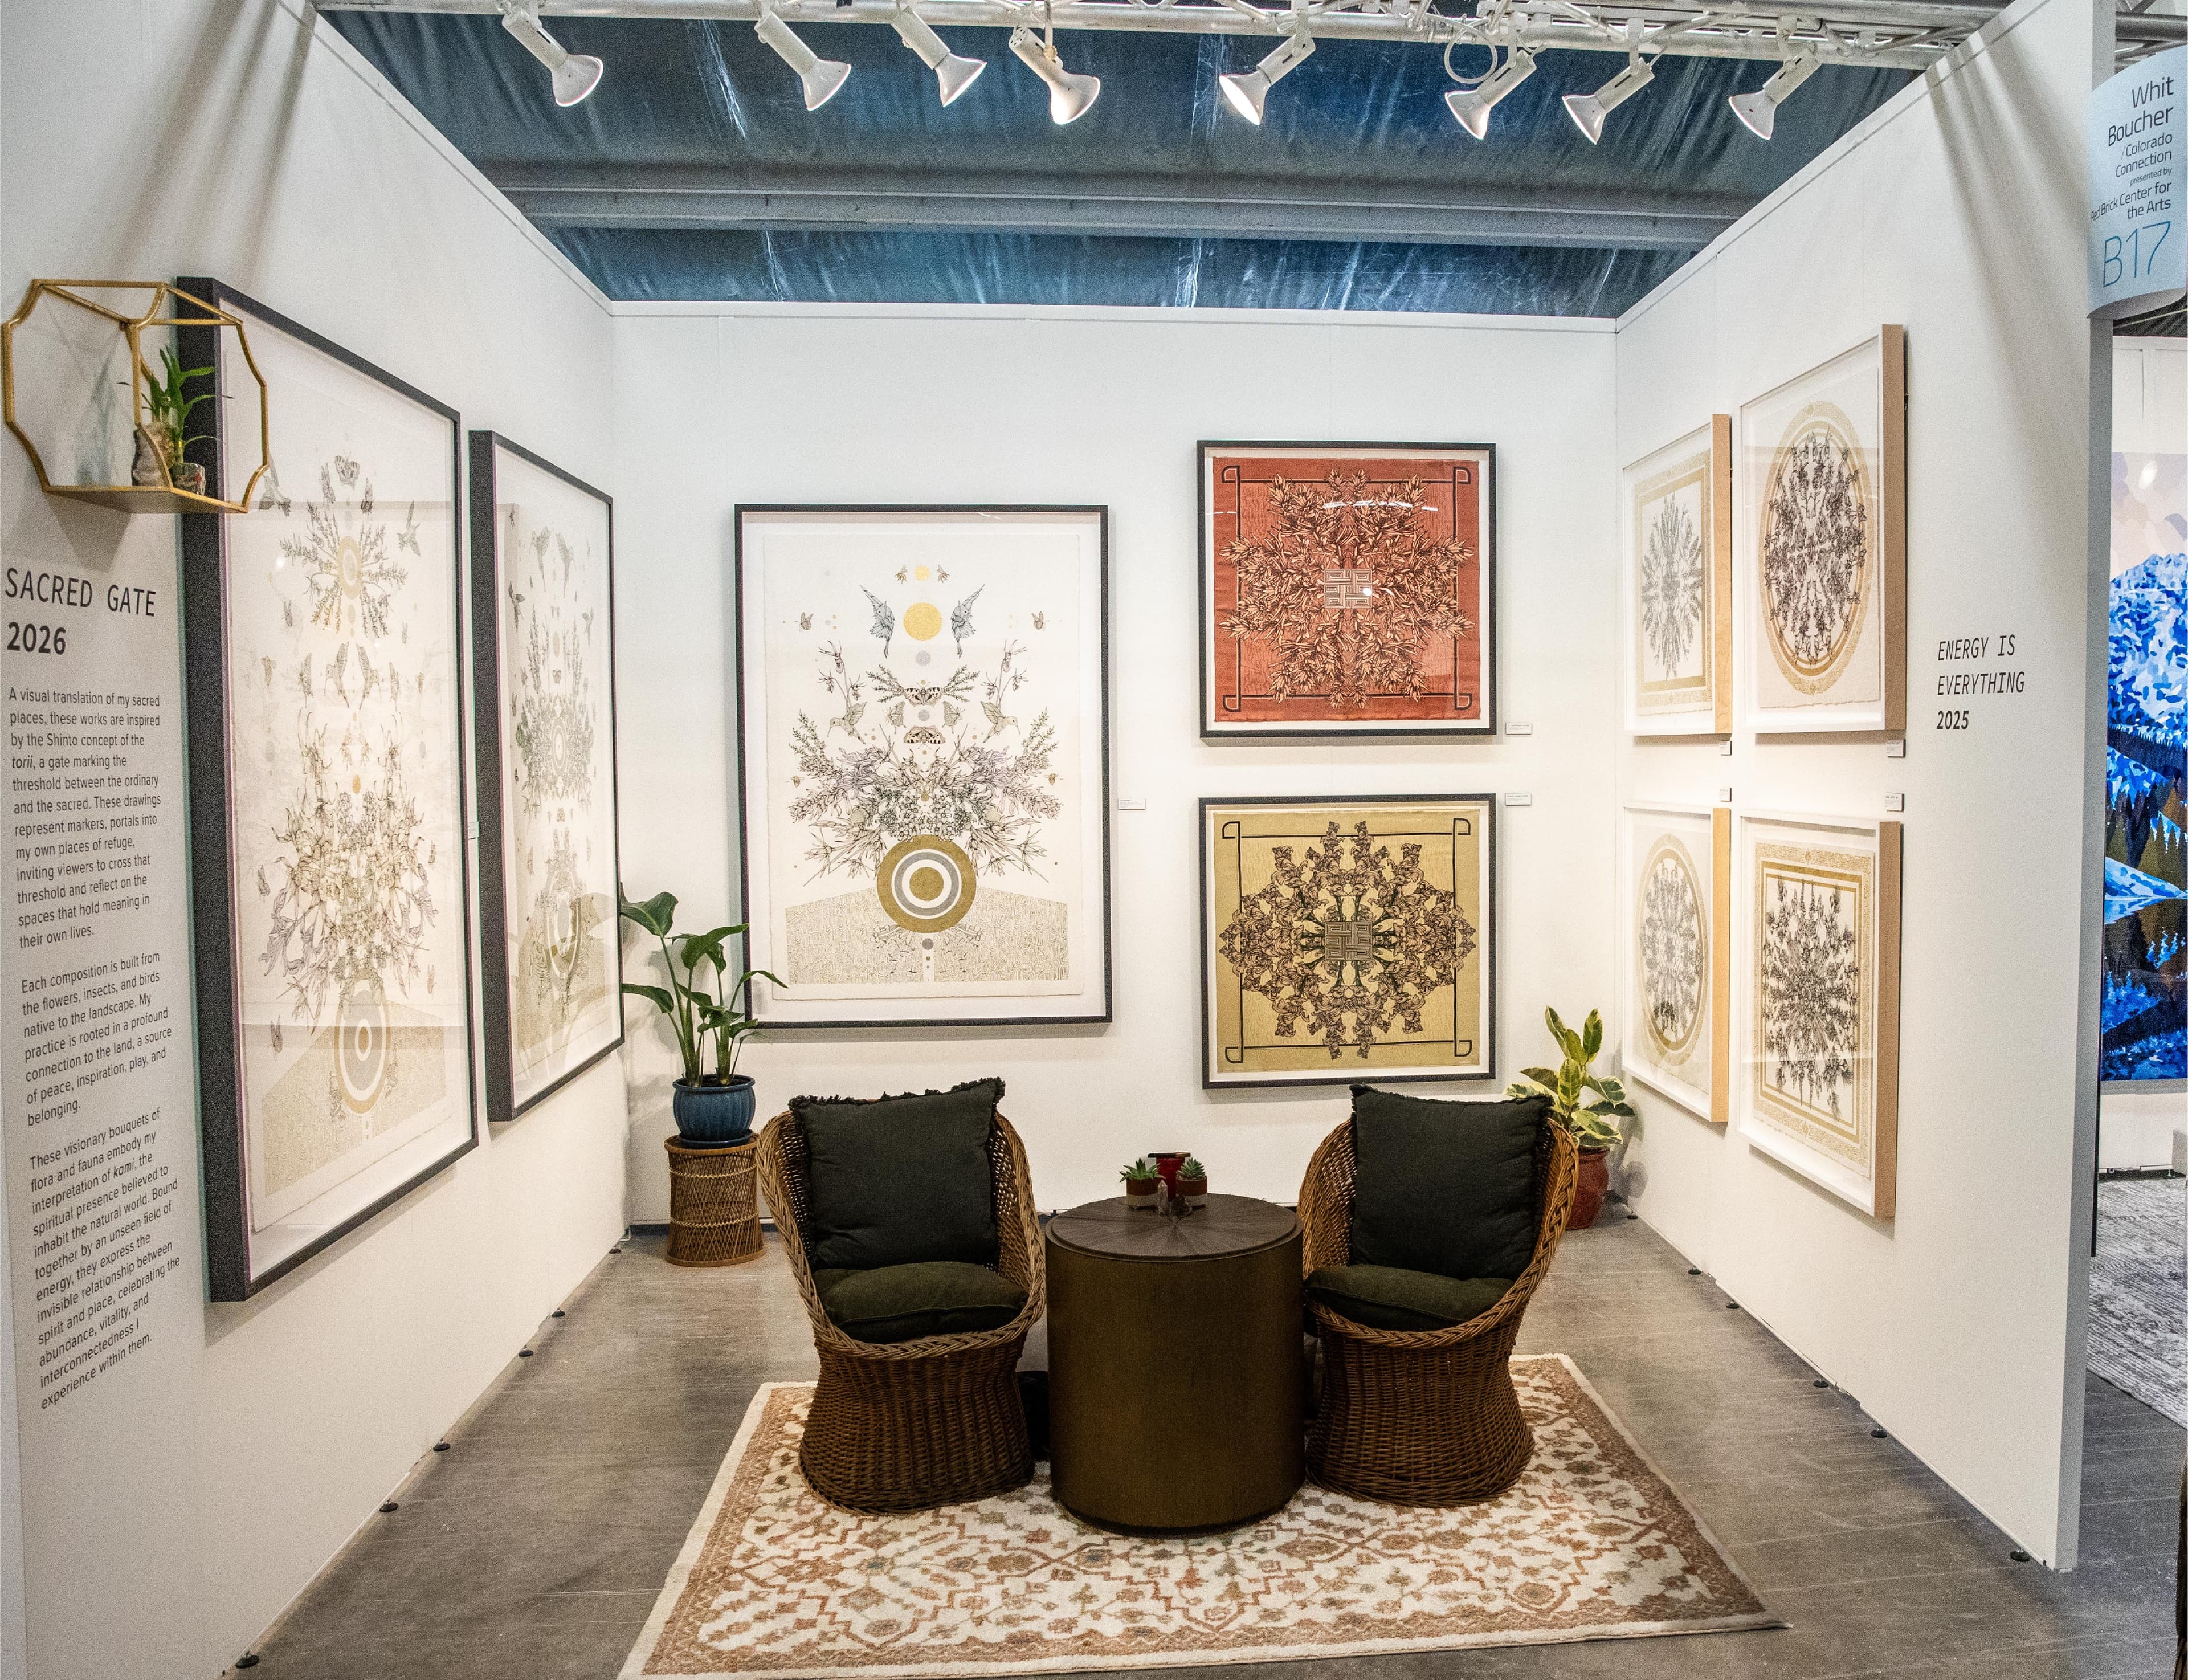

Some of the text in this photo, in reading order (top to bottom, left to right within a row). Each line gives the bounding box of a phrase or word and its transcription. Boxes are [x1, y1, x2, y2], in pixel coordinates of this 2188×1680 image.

[2132, 76, 2174, 108] Whit
[2108, 107, 2174, 146] Boucher
[2116, 150, 2172, 177] Connection
[2130, 168, 2162, 187] presented
[2101, 197, 2118, 215] Brick
[2120, 187, 2152, 206] Center
[2154, 181, 2172, 195] for
[2128, 199, 2171, 219] the Arts
[2103, 221, 2171, 288] B17
[5, 568, 156, 617] SACRED GATE
[6, 622, 66, 655] 2026
[1938, 634, 2015, 661] ENERGY IS
[9, 687, 160, 708] A visual translation of my sacred
[1937, 671, 2025, 695] EVERYTHING
[10, 711, 160, 728] places, these works are inspired
[1936, 710, 1969, 729] 2025
[11, 733, 144, 749] by the Shinto concept of the
[12, 755, 126, 771] torii, a gate marking the
[12, 774, 158, 791] threshold between the ordinary
[14, 795, 161, 814] and the sacred. These drawings
[15, 815, 157, 838] represent markers, portals into
[16, 837, 135, 861] my own places of refuge,
[17, 854, 150, 881] inviting viewers to cross that
[17, 875, 147, 904] threshold and reflect on the
[19, 894, 149, 928] spaces that hold meaning in
[19, 926, 94, 948] their own lives.
[22, 953, 160, 993] Each composition is built from
[22, 972, 160, 1016] the flowers, insects, and birds
[24, 993, 151, 1037] native to the landscape. My
[25, 1007, 168, 1063] practice is rooted in a profound
[26, 1028, 172, 1082] connection to the land, a source
[27, 1047, 166, 1104] of peace, inspiration, play, and
[28, 1100, 80, 1126] belonging.
[30, 1107, 160, 1169] These visionary bouquets of
[31, 1132, 156, 1192] flora and fauna embody my
[32, 1153, 152, 1214] interpretation of kami, the
[33, 1166, 168, 1236] spiritual presence believed to
[35, 1179, 178, 1258] inhabit the natural world. Bound
[35, 1200, 171, 1279] together by an unseen field of
[36, 1234, 150, 1301] energy, they express the
[38, 1242, 172, 1323] invisible relationship between
[39, 1257, 179, 1345] spirit and place, celebrating the
[40, 1292, 149, 1367] abundance, vitality, and
[40, 1319, 139, 1388] interconnectedness I
[42, 1334, 152, 1409] experience within them.
